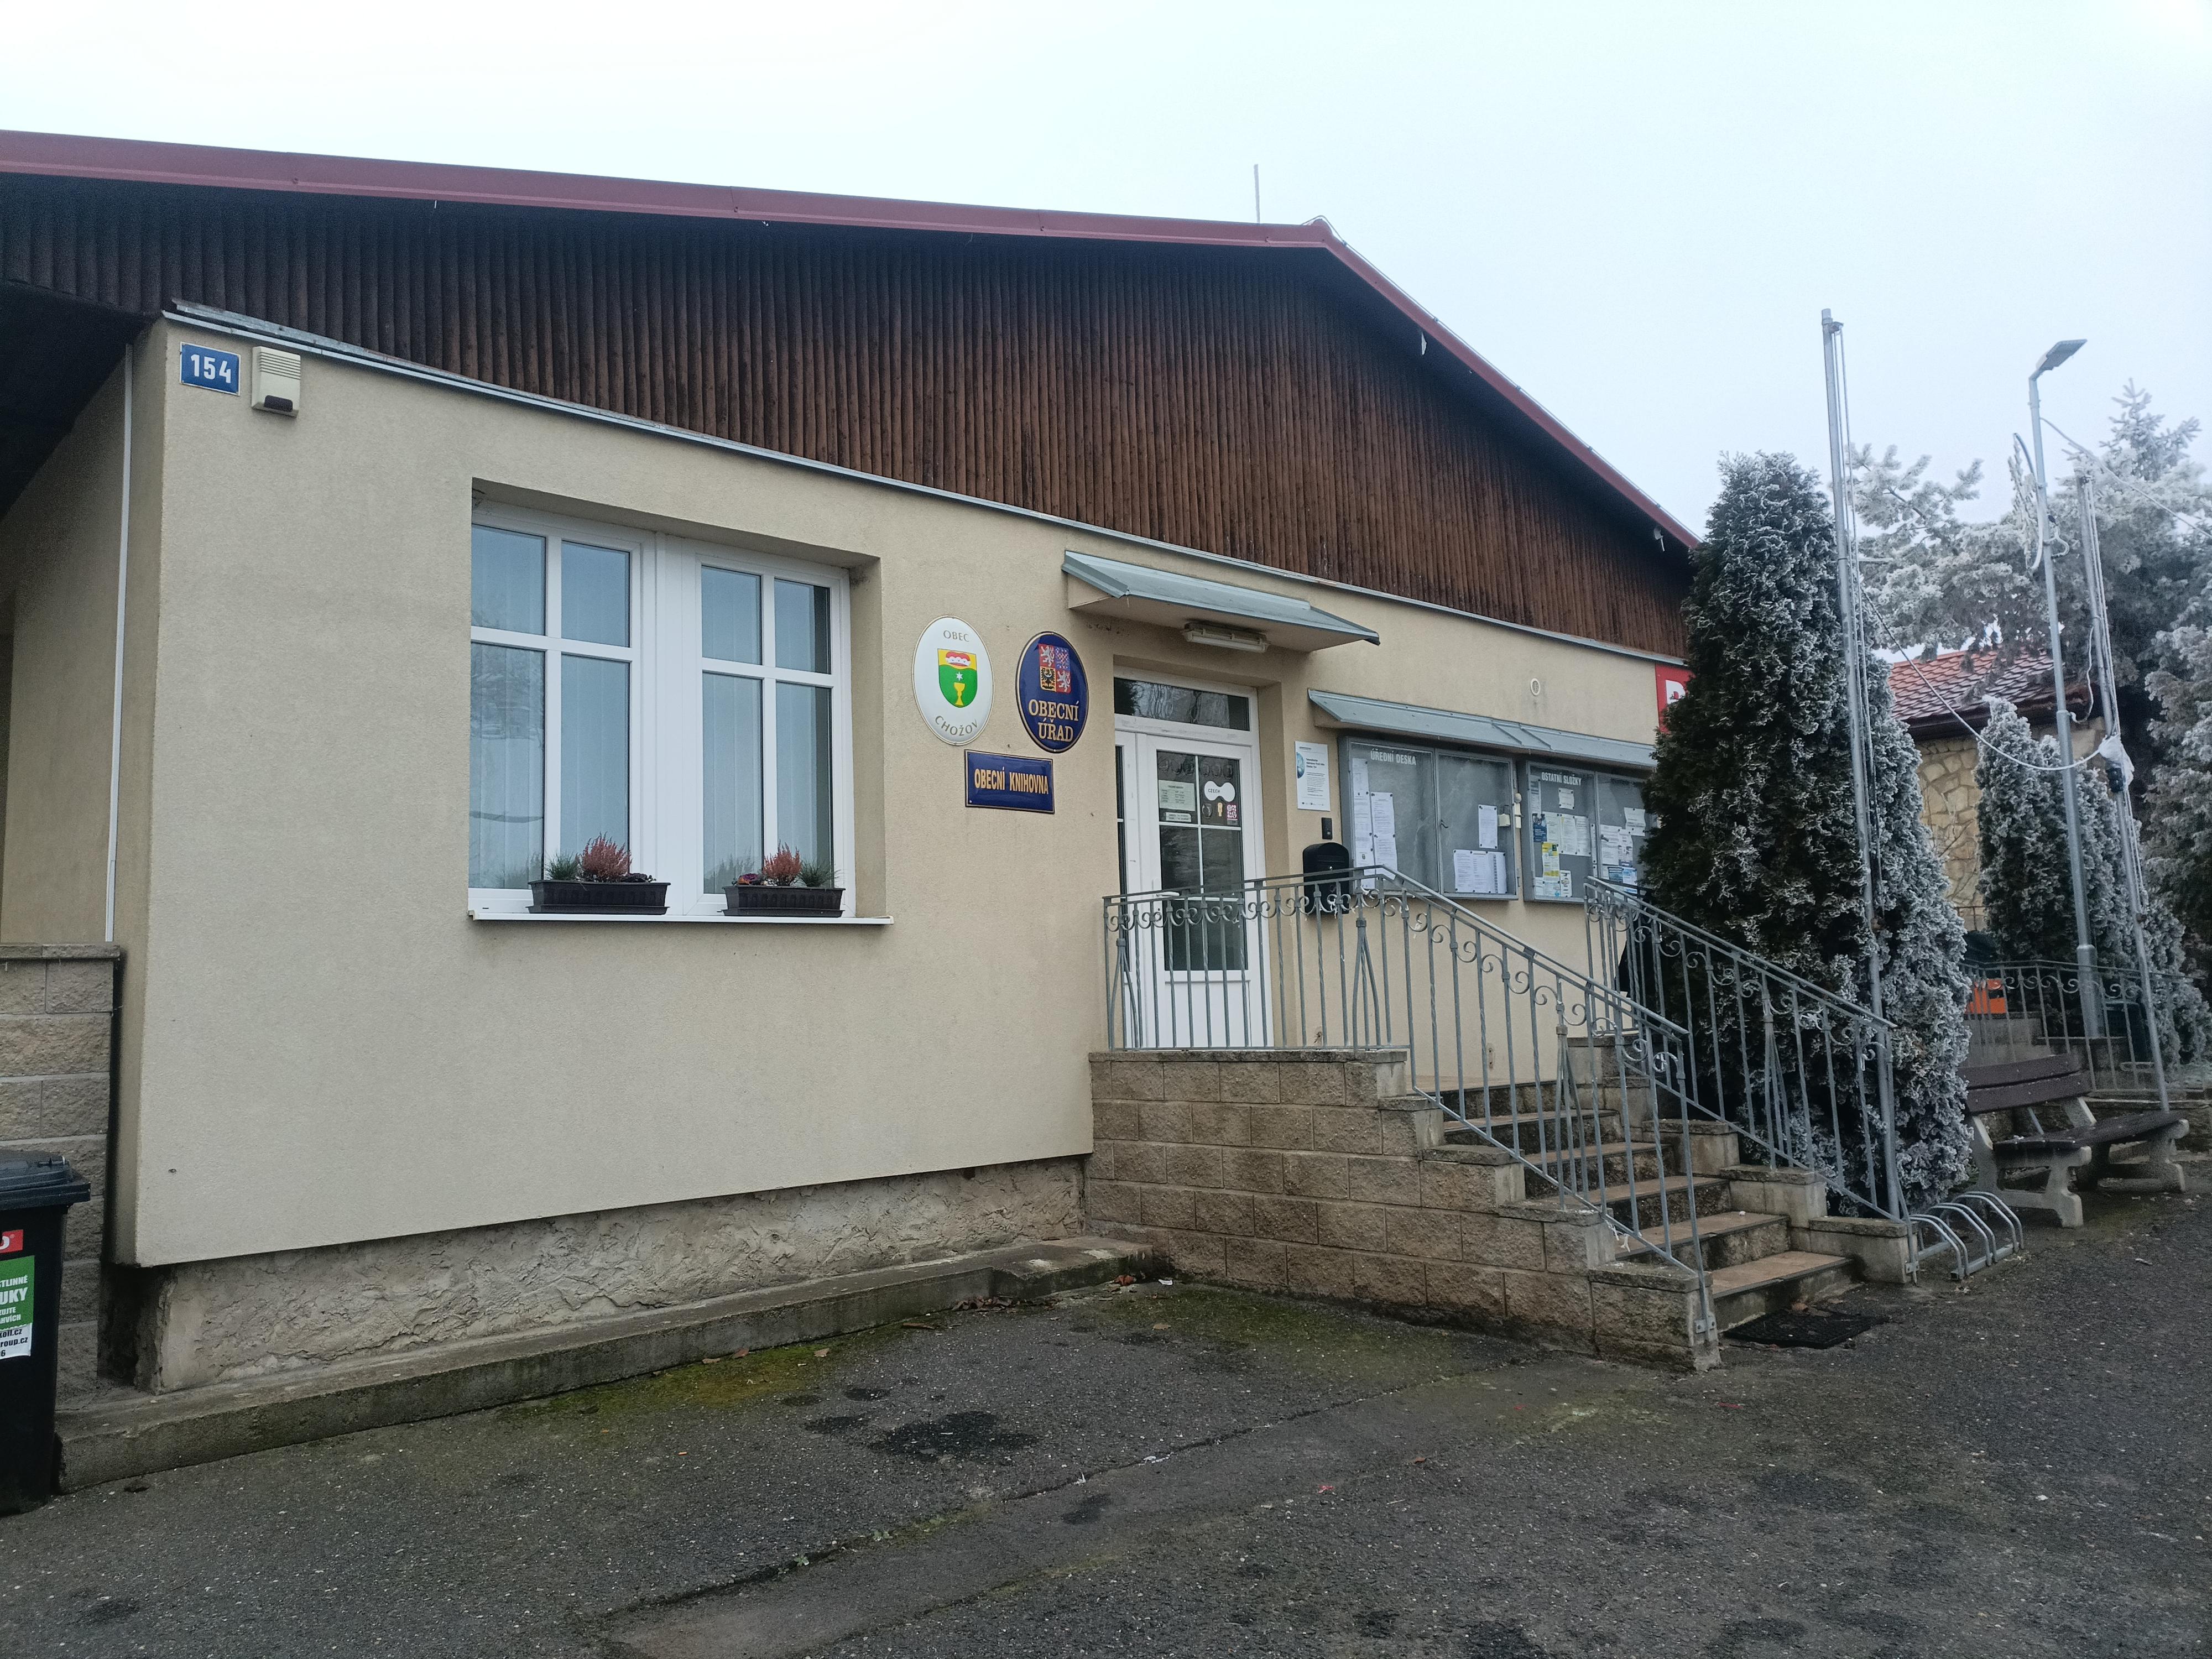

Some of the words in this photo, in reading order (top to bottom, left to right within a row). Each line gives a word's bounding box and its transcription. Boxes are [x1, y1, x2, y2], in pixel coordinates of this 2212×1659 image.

[190, 354, 231, 383] 154
[943, 630, 969, 642] OBEC
[1028, 699, 1079, 722] OBECNÍ
[935, 715, 978, 737] CHOŽOV
[1038, 718, 1074, 743] ÚŘAD
[1370, 748, 1394, 763] ÚŘEDNÍ
[1396, 754, 1417, 765] DESKA
[974, 767, 1005, 790] OBECNÍ
[1009, 772, 1048, 795] KNIHOVNA
[1541, 772, 1562, 783] OSTATNÍ
[1563, 774, 1582, 786] SLOŽKY
[0, 1275, 28, 1287] TLINNÉ
